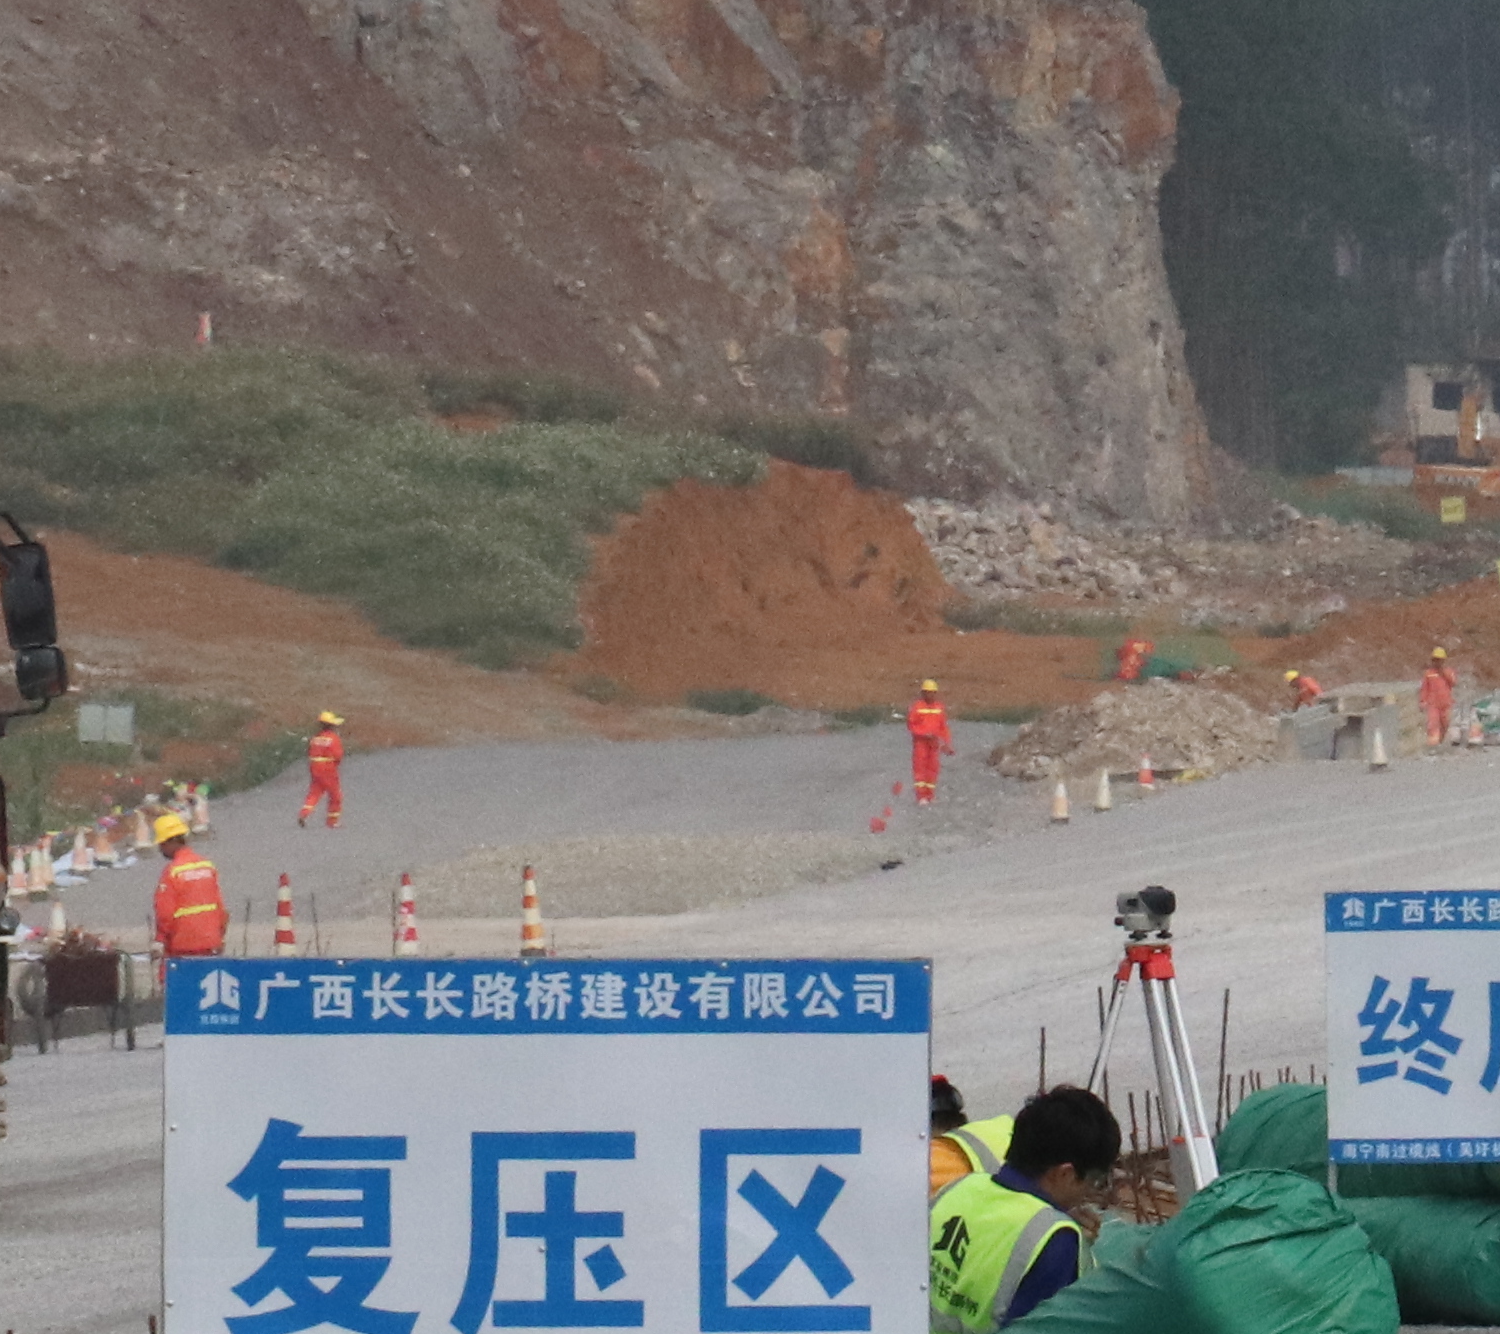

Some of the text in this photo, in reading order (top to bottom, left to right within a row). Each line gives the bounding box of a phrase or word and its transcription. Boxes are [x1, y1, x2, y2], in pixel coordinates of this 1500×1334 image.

[254, 970, 897, 1021] 广西长长路桥建设有限公司
